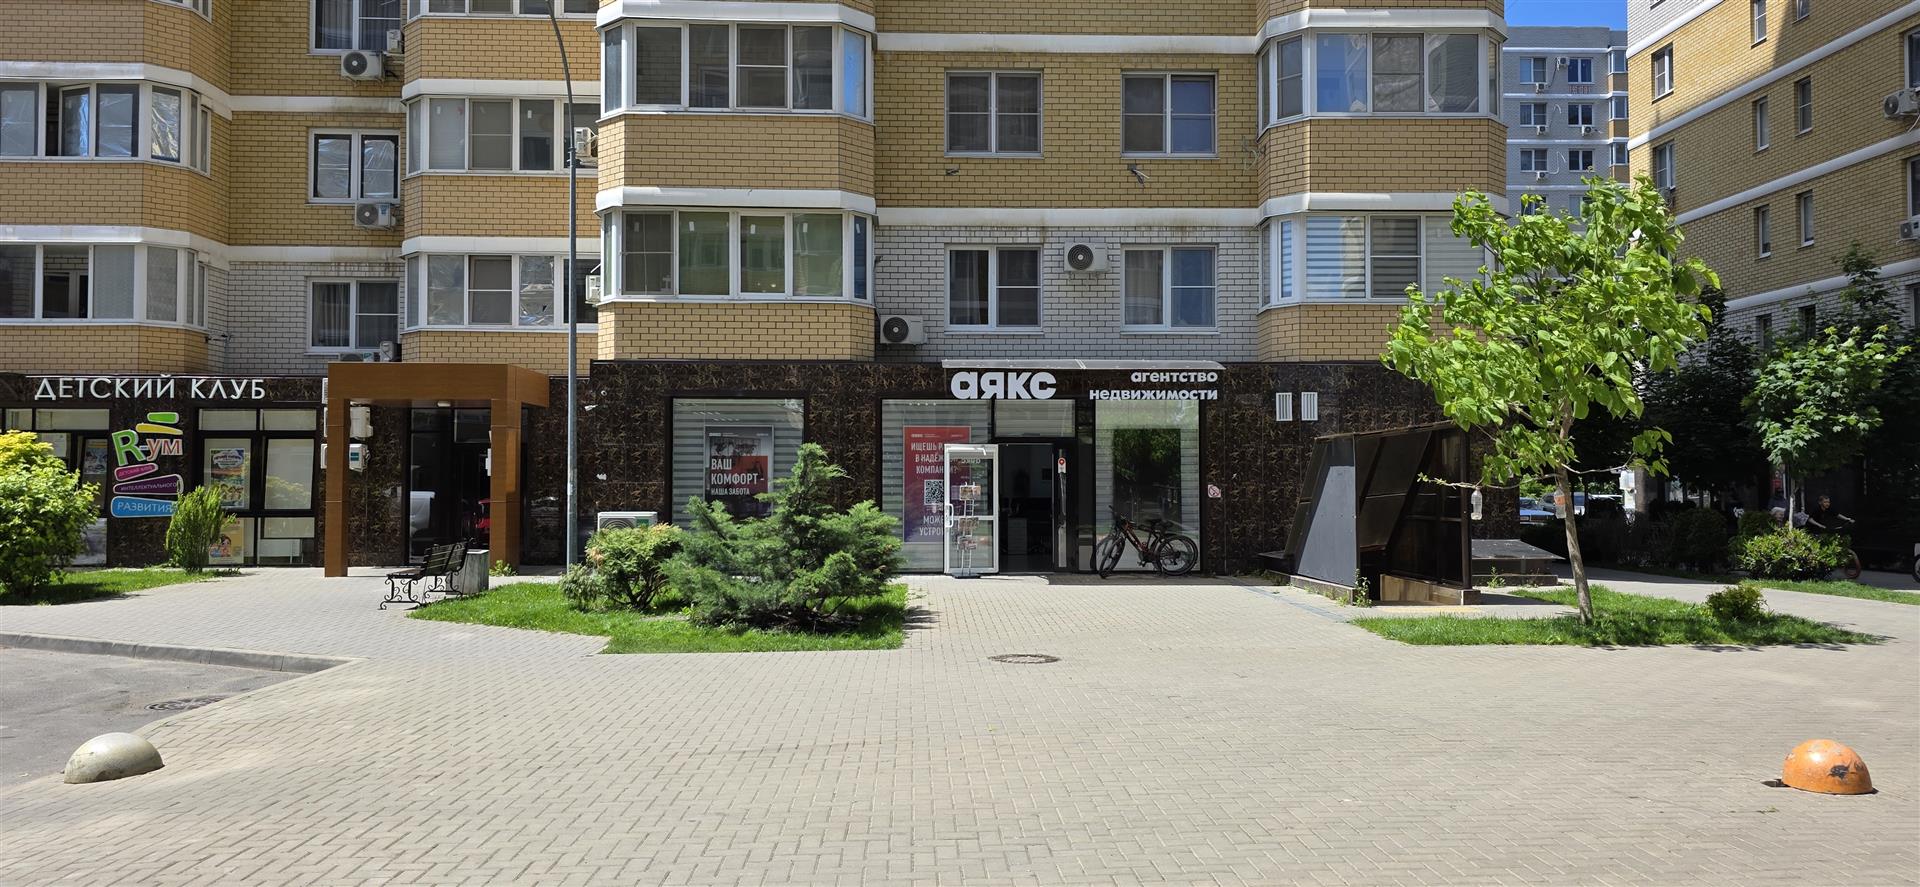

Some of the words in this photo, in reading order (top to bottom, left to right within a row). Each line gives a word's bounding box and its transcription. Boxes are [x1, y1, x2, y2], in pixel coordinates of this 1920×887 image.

[1131, 371, 1218, 384] агентство
[34, 374, 175, 400] ДЕТСКИЙ
[191, 379, 266, 400] КЛУБ
[950, 371, 1057, 400] аякс
[1089, 389, 1218, 401] недвижимости
[911, 442, 937, 451] ИЩЕШЬ
[711, 458, 732, 470] ВАШ
[915, 454, 920, 462] В
[711, 472, 759, 485] КОМФОРТ
[711, 487, 728, 496] НАША
[729, 487, 751, 496] ЗАБОТА
[117, 502, 173, 513] РАЗВИТИЯ
